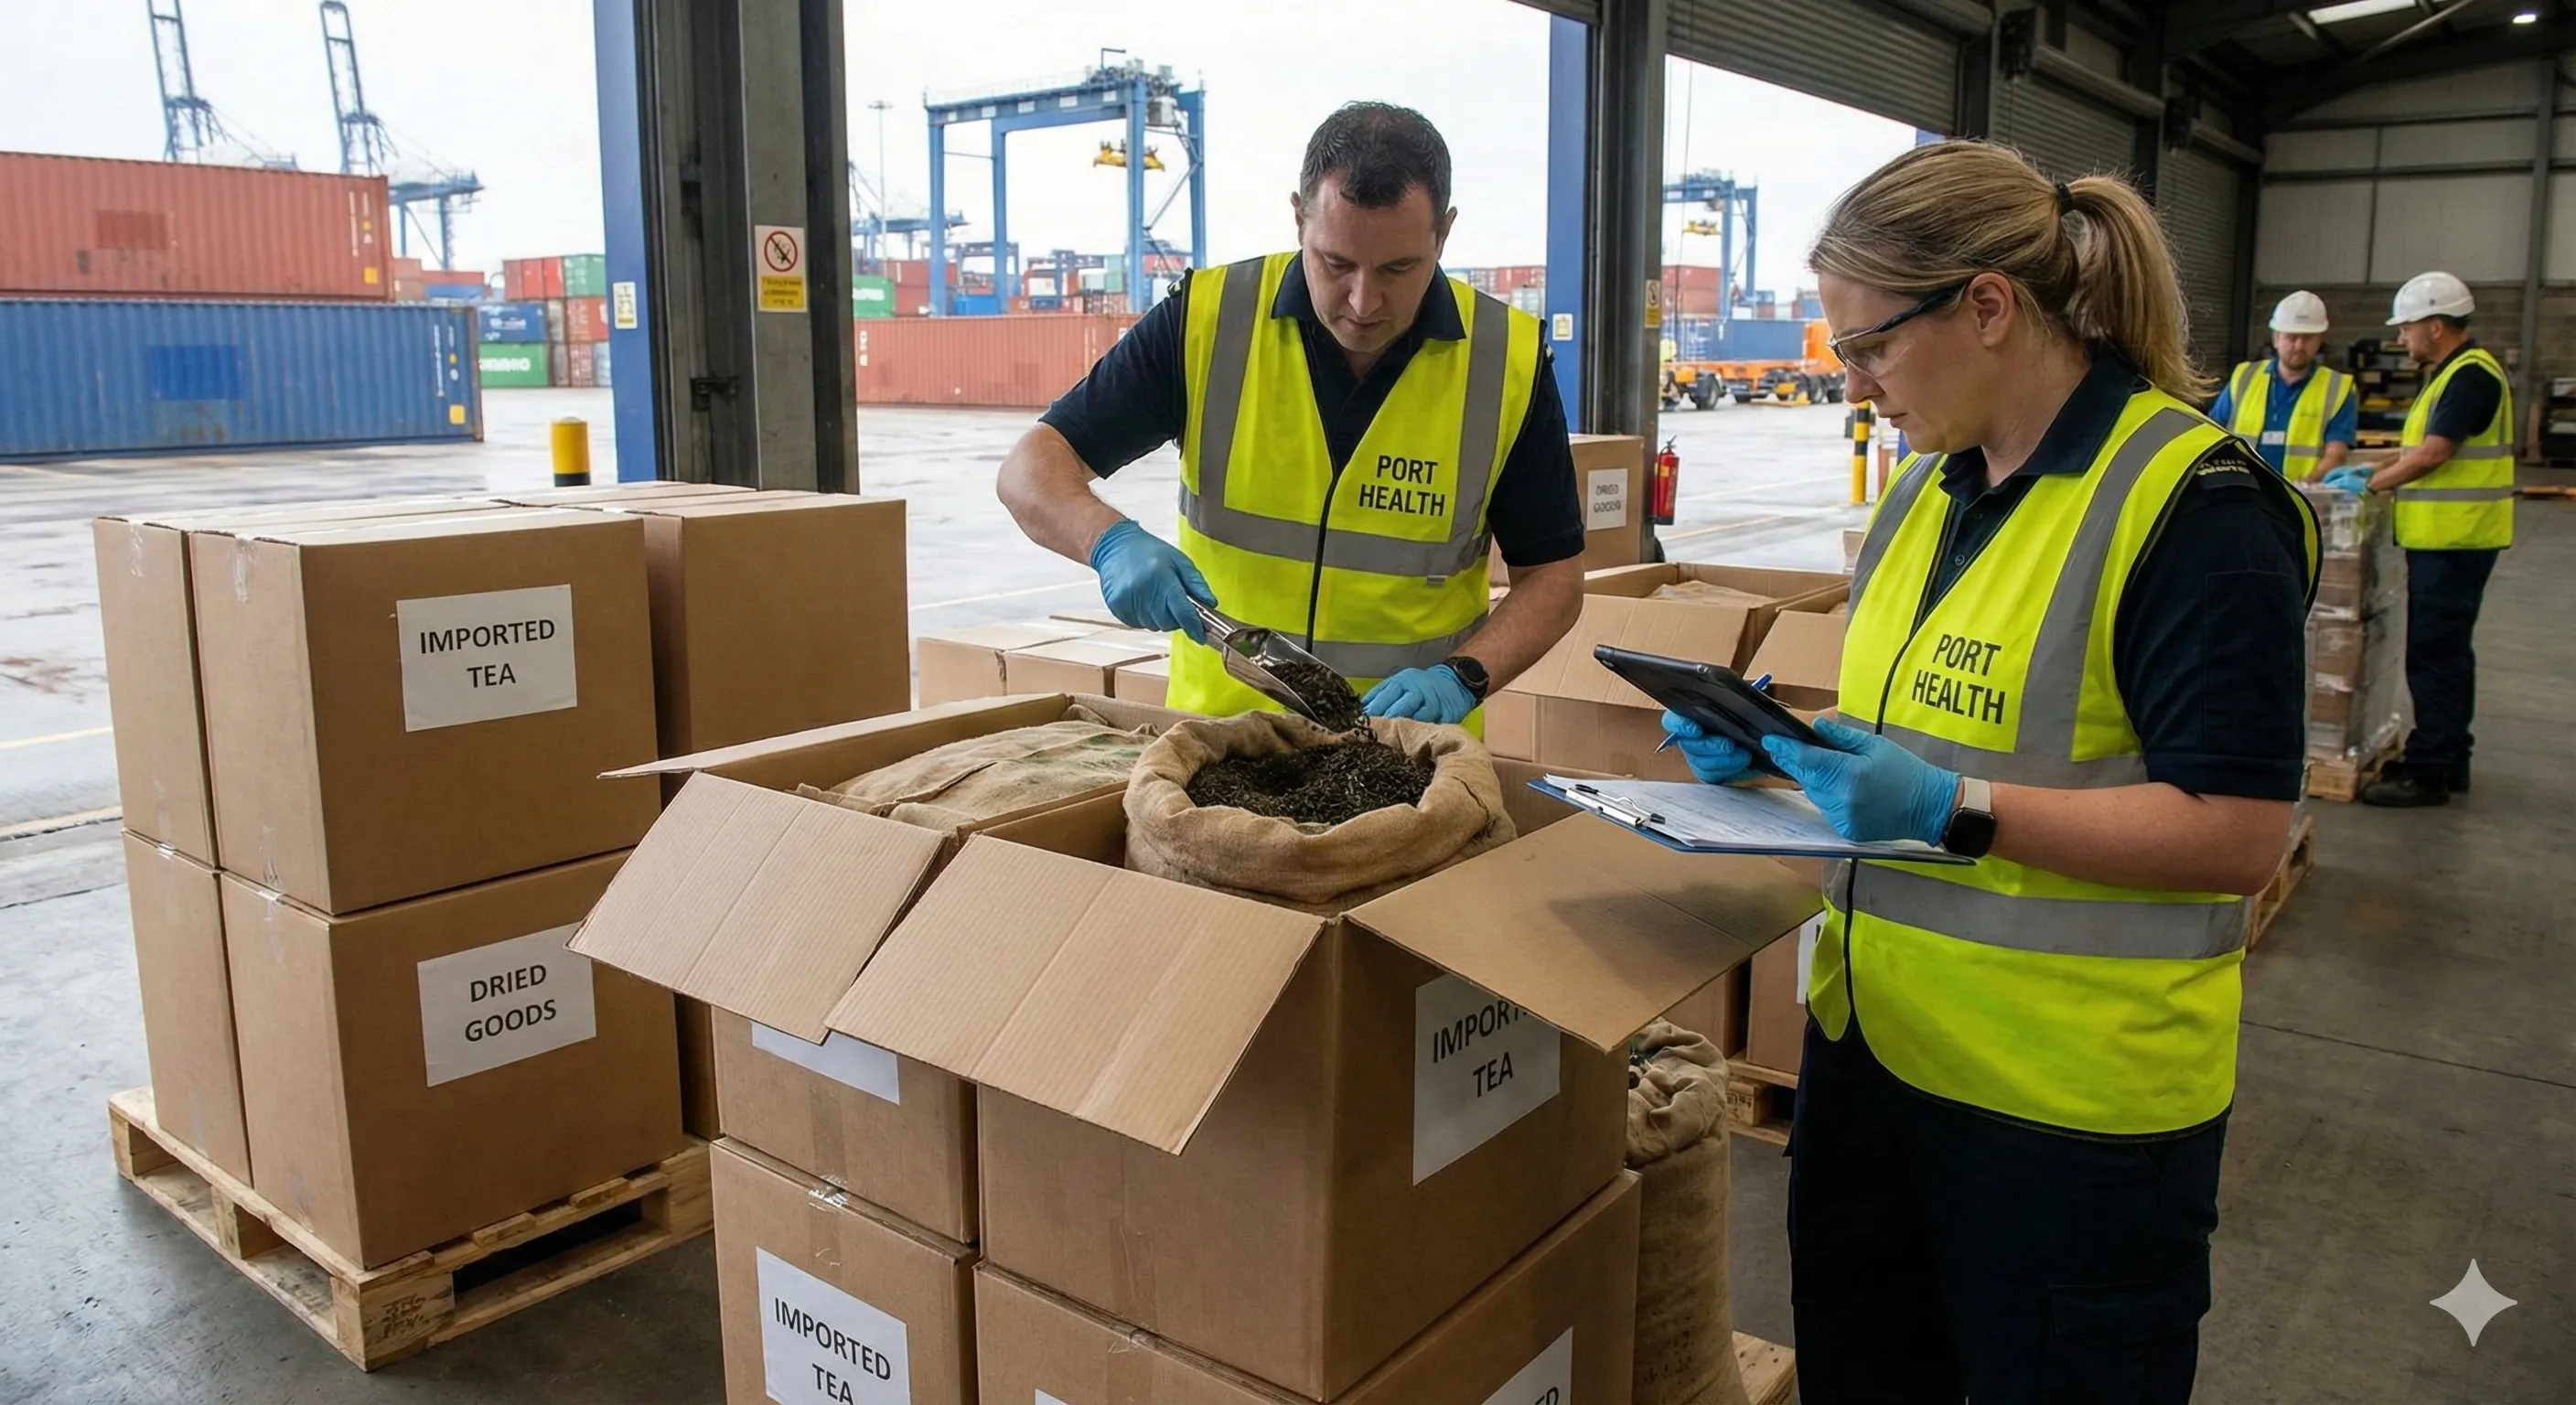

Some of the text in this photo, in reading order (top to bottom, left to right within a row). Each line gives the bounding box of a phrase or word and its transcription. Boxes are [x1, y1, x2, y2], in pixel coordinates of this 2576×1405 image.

[1376, 455, 1438, 485] PORT
[1358, 483, 1445, 517] HEALTH
[420, 619, 555, 654] IMPORTED
[1932, 634, 2002, 677] PORT
[467, 662, 516, 689] TEA
[1911, 669, 2006, 724] HEALTH
[470, 964, 547, 1003] DRIED
[465, 999, 557, 1042] GOODS
[1433, 999, 1528, 1064] IMPOR
[1473, 1051, 1514, 1099] TEA
[775, 1297, 891, 1380] IMPORTED
[811, 1363, 853, 1405] TEA
